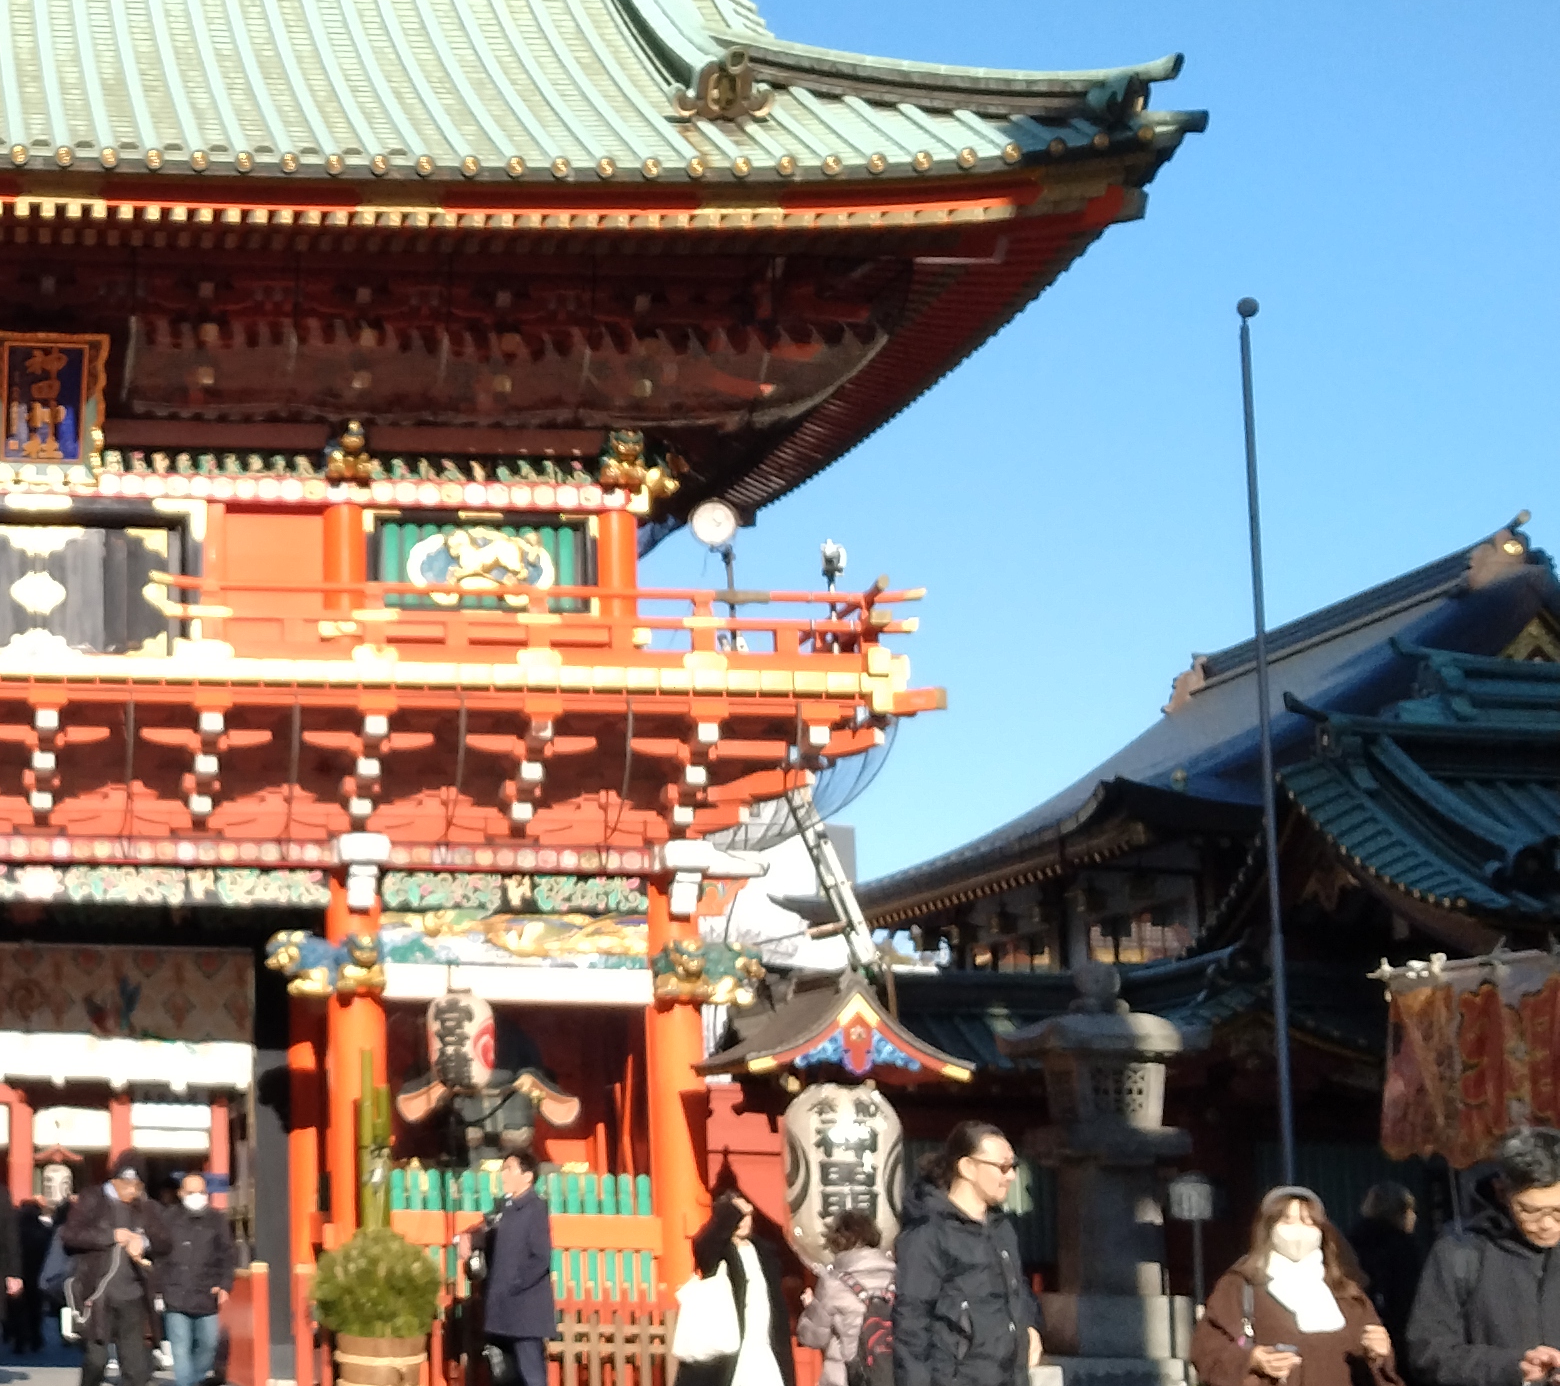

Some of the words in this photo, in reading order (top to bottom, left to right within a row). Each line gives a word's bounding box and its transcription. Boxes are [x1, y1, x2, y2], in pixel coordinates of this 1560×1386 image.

[21, 345, 69, 459] 神田神社
[813, 1118, 881, 1250] 神田明
